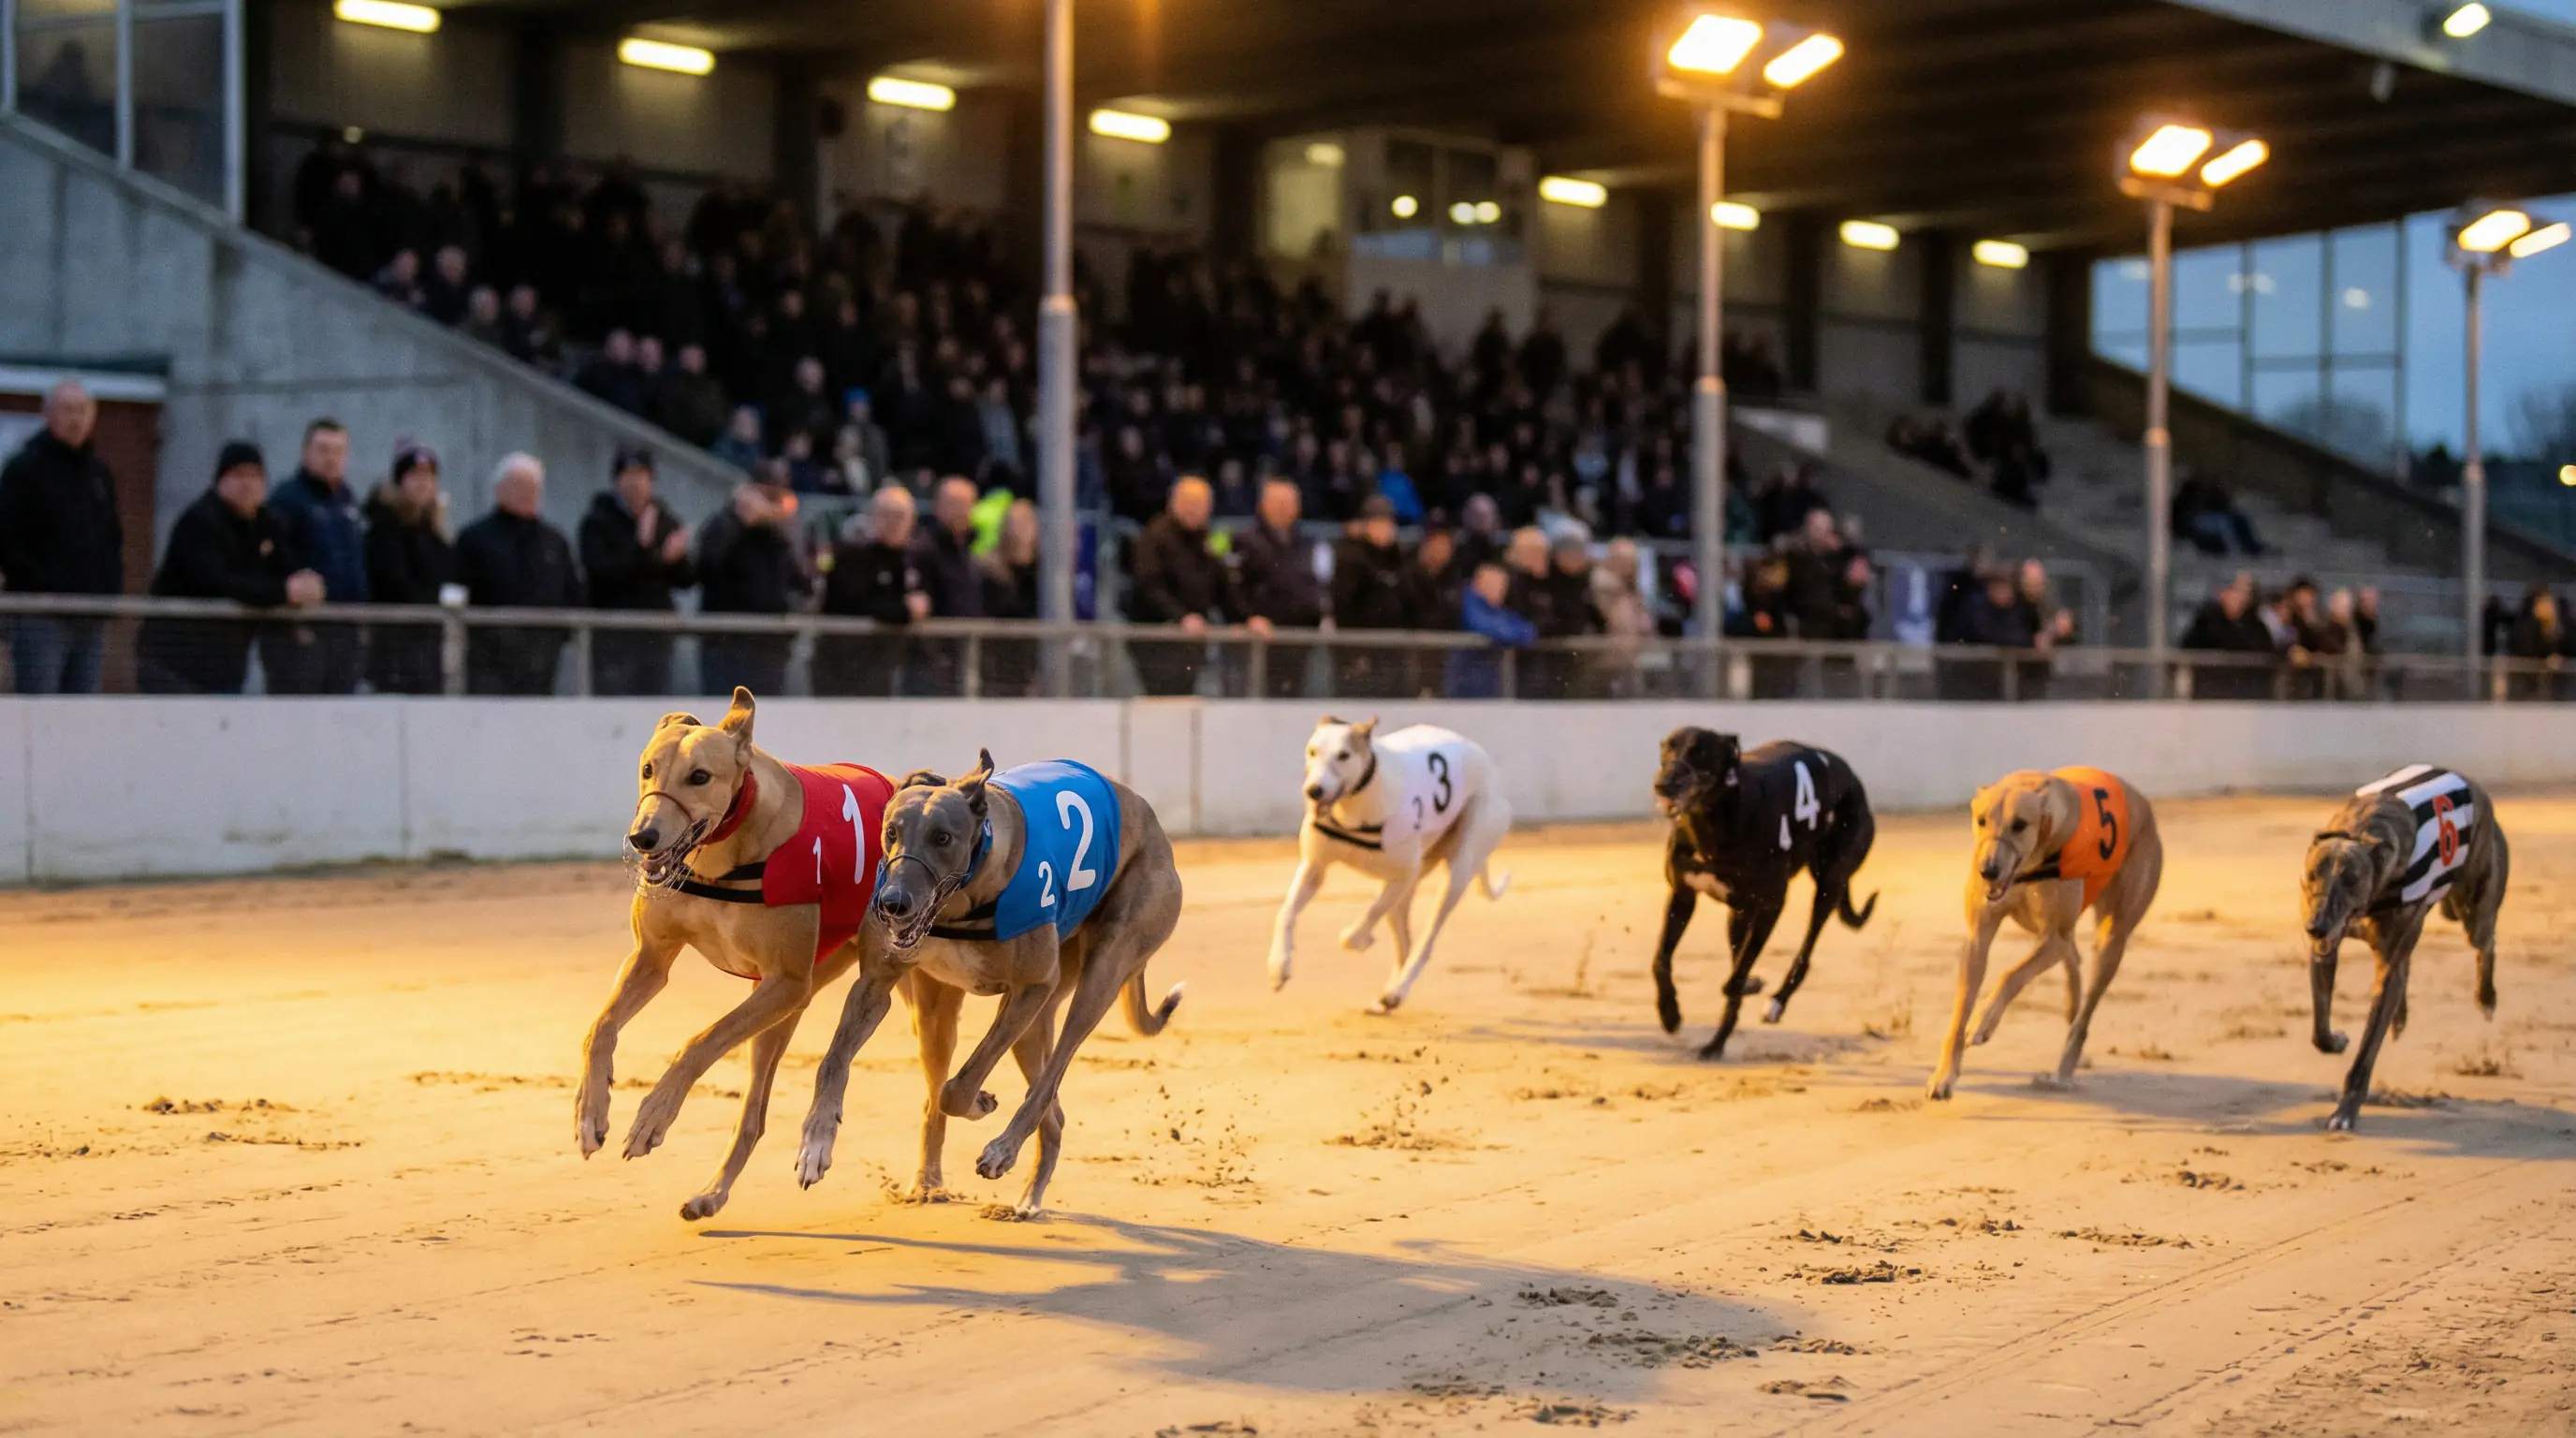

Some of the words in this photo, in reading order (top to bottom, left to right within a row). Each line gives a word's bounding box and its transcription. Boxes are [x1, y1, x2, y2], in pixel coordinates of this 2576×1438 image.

[1427, 751, 1452, 814] 3
[1793, 759, 1822, 831] 4
[812, 836, 822, 885] 1
[842, 783, 865, 885] 1
[1055, 789, 1097, 892] 2
[2093, 788, 2117, 861] 5
[2432, 794, 2459, 868] 6
[1037, 860, 1056, 908] 2
